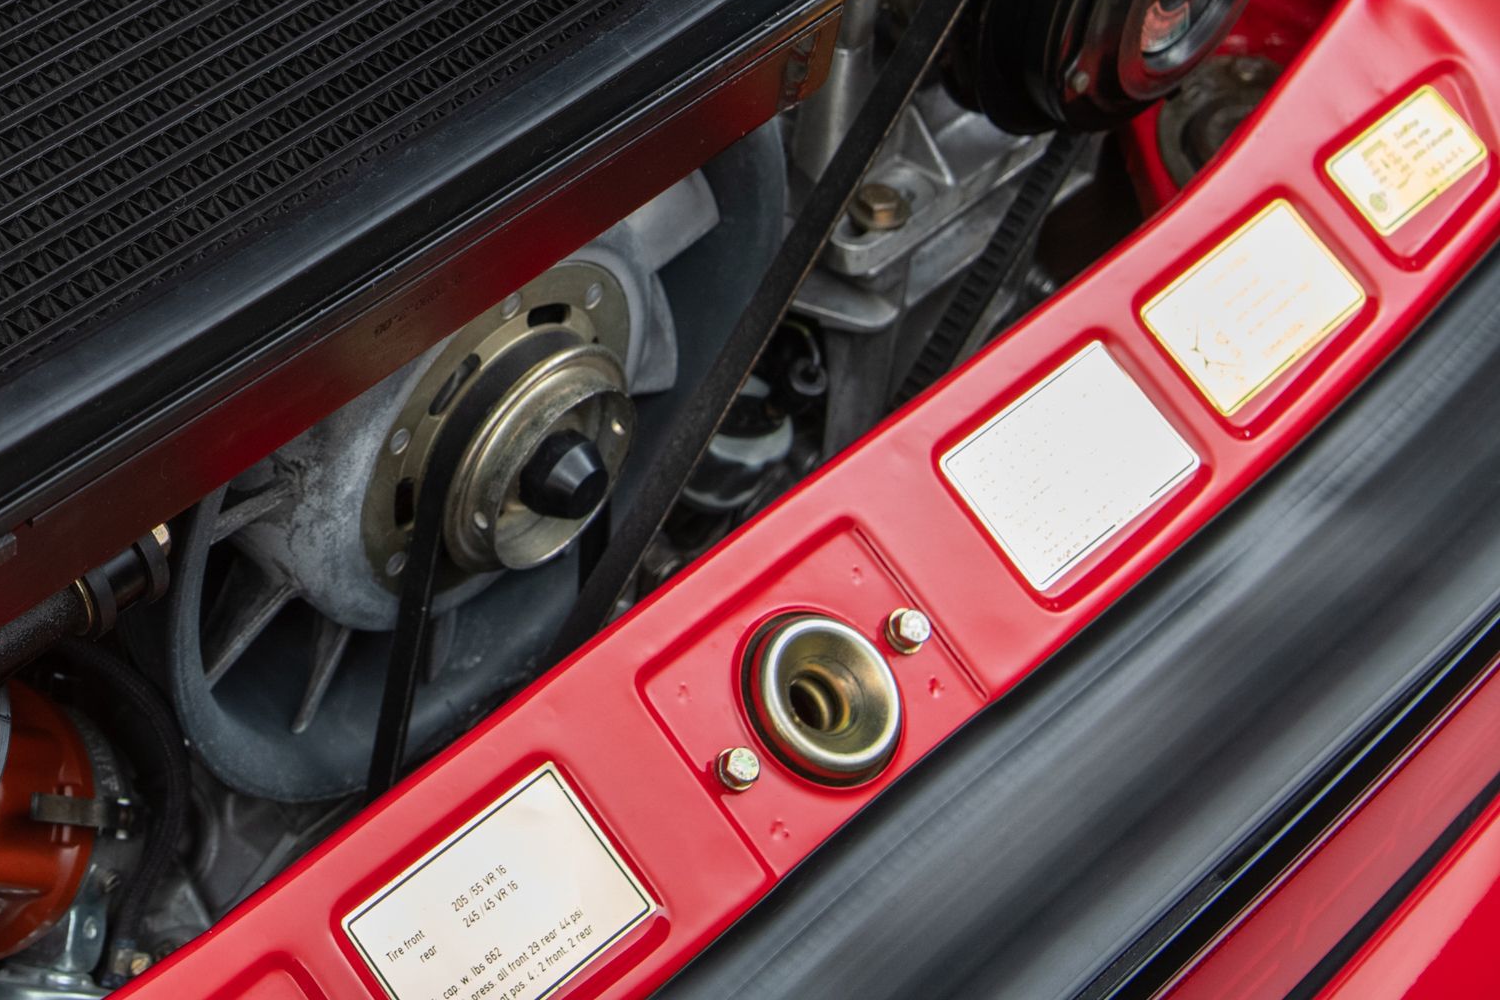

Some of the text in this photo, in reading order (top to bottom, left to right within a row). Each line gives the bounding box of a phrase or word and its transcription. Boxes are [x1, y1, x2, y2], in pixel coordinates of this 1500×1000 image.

[451, 894, 469, 912] 205
[482, 872, 497, 886] VR
[495, 864, 507, 876] 16
[462, 910, 481, 928] 245
[494, 887, 509, 901] VR
[507, 880, 519, 891] 16
[386, 929, 426, 963] Tire front
[419, 944, 438, 964] rear
[470, 962, 486, 977] lbs
[484, 946, 503, 965] 662
[497, 967, 509, 982] all
[507, 951, 530, 973] front
[527, 941, 541, 956] 29
[540, 928, 558, 947] rear
[559, 917, 571, 930] 44
[570, 907, 585, 924] psi
[510, 980, 528, 999] pos.
[538, 961, 547, 973] 2
[567, 938, 576, 949] 2
[576, 924, 594, 943] rear
